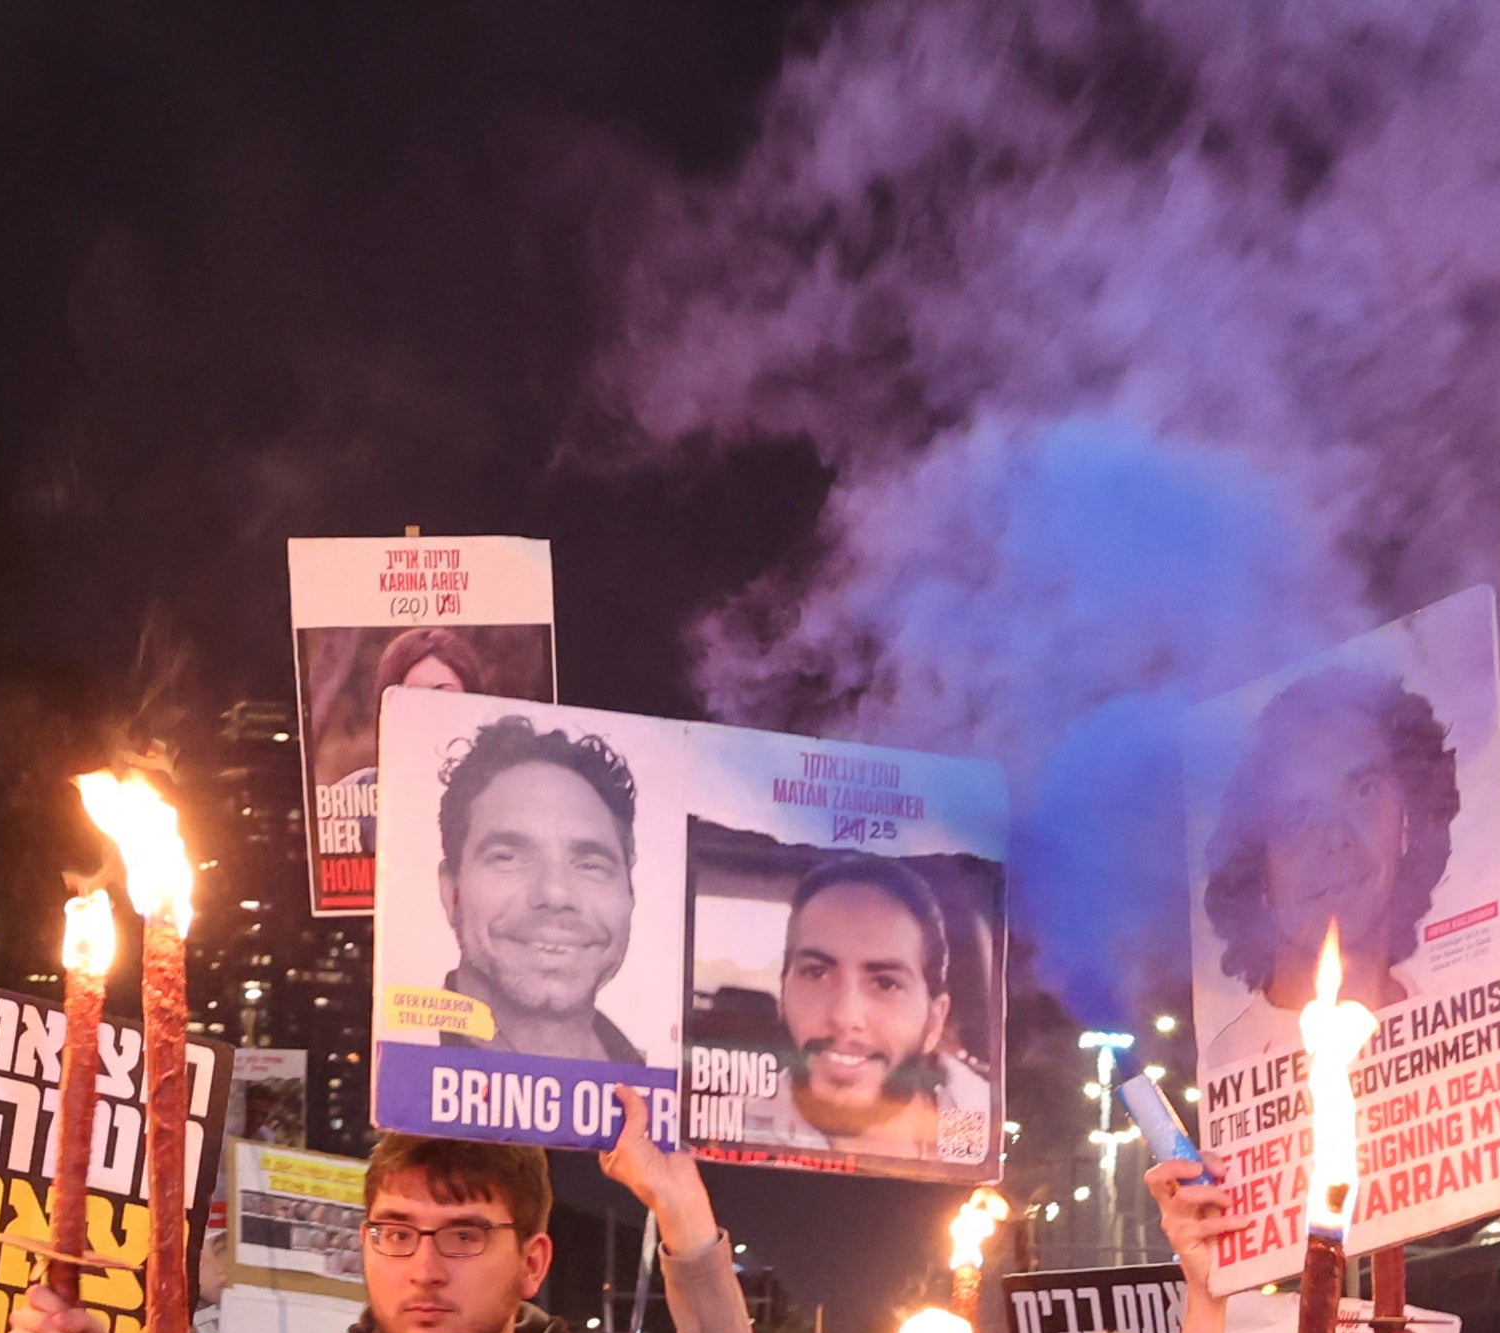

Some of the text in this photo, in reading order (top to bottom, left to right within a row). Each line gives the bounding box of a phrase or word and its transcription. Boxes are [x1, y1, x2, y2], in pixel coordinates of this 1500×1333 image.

[380, 571, 469, 592] KARINA ARIEV
[390, 598, 429, 616] (20)
[773, 778, 828, 808] MATAN
[319, 819, 362, 854] HER
[869, 820, 897, 839] 25
[321, 857, 375, 893] HOM
[398, 1012, 468, 1030] STILL CAPTIVE
[691, 1046, 778, 1098] BRING
[1208, 1069, 1246, 1112] MY
[1252, 1050, 1307, 1097] LIFE
[431, 1066, 561, 1133] BRING
[689, 1093, 745, 1142] HIM
[1210, 1117, 1228, 1149] OF
[1228, 1108, 1251, 1142] THE
[1255, 1090, 1314, 1132] ISRA
[1237, 1135, 1292, 1178] THEY
[1368, 1091, 1420, 1133] SIGN
[1426, 1085, 1444, 1114] A
[1357, 1115, 1463, 1176] SIGNING
[1218, 1205, 1303, 1268] DEAT
